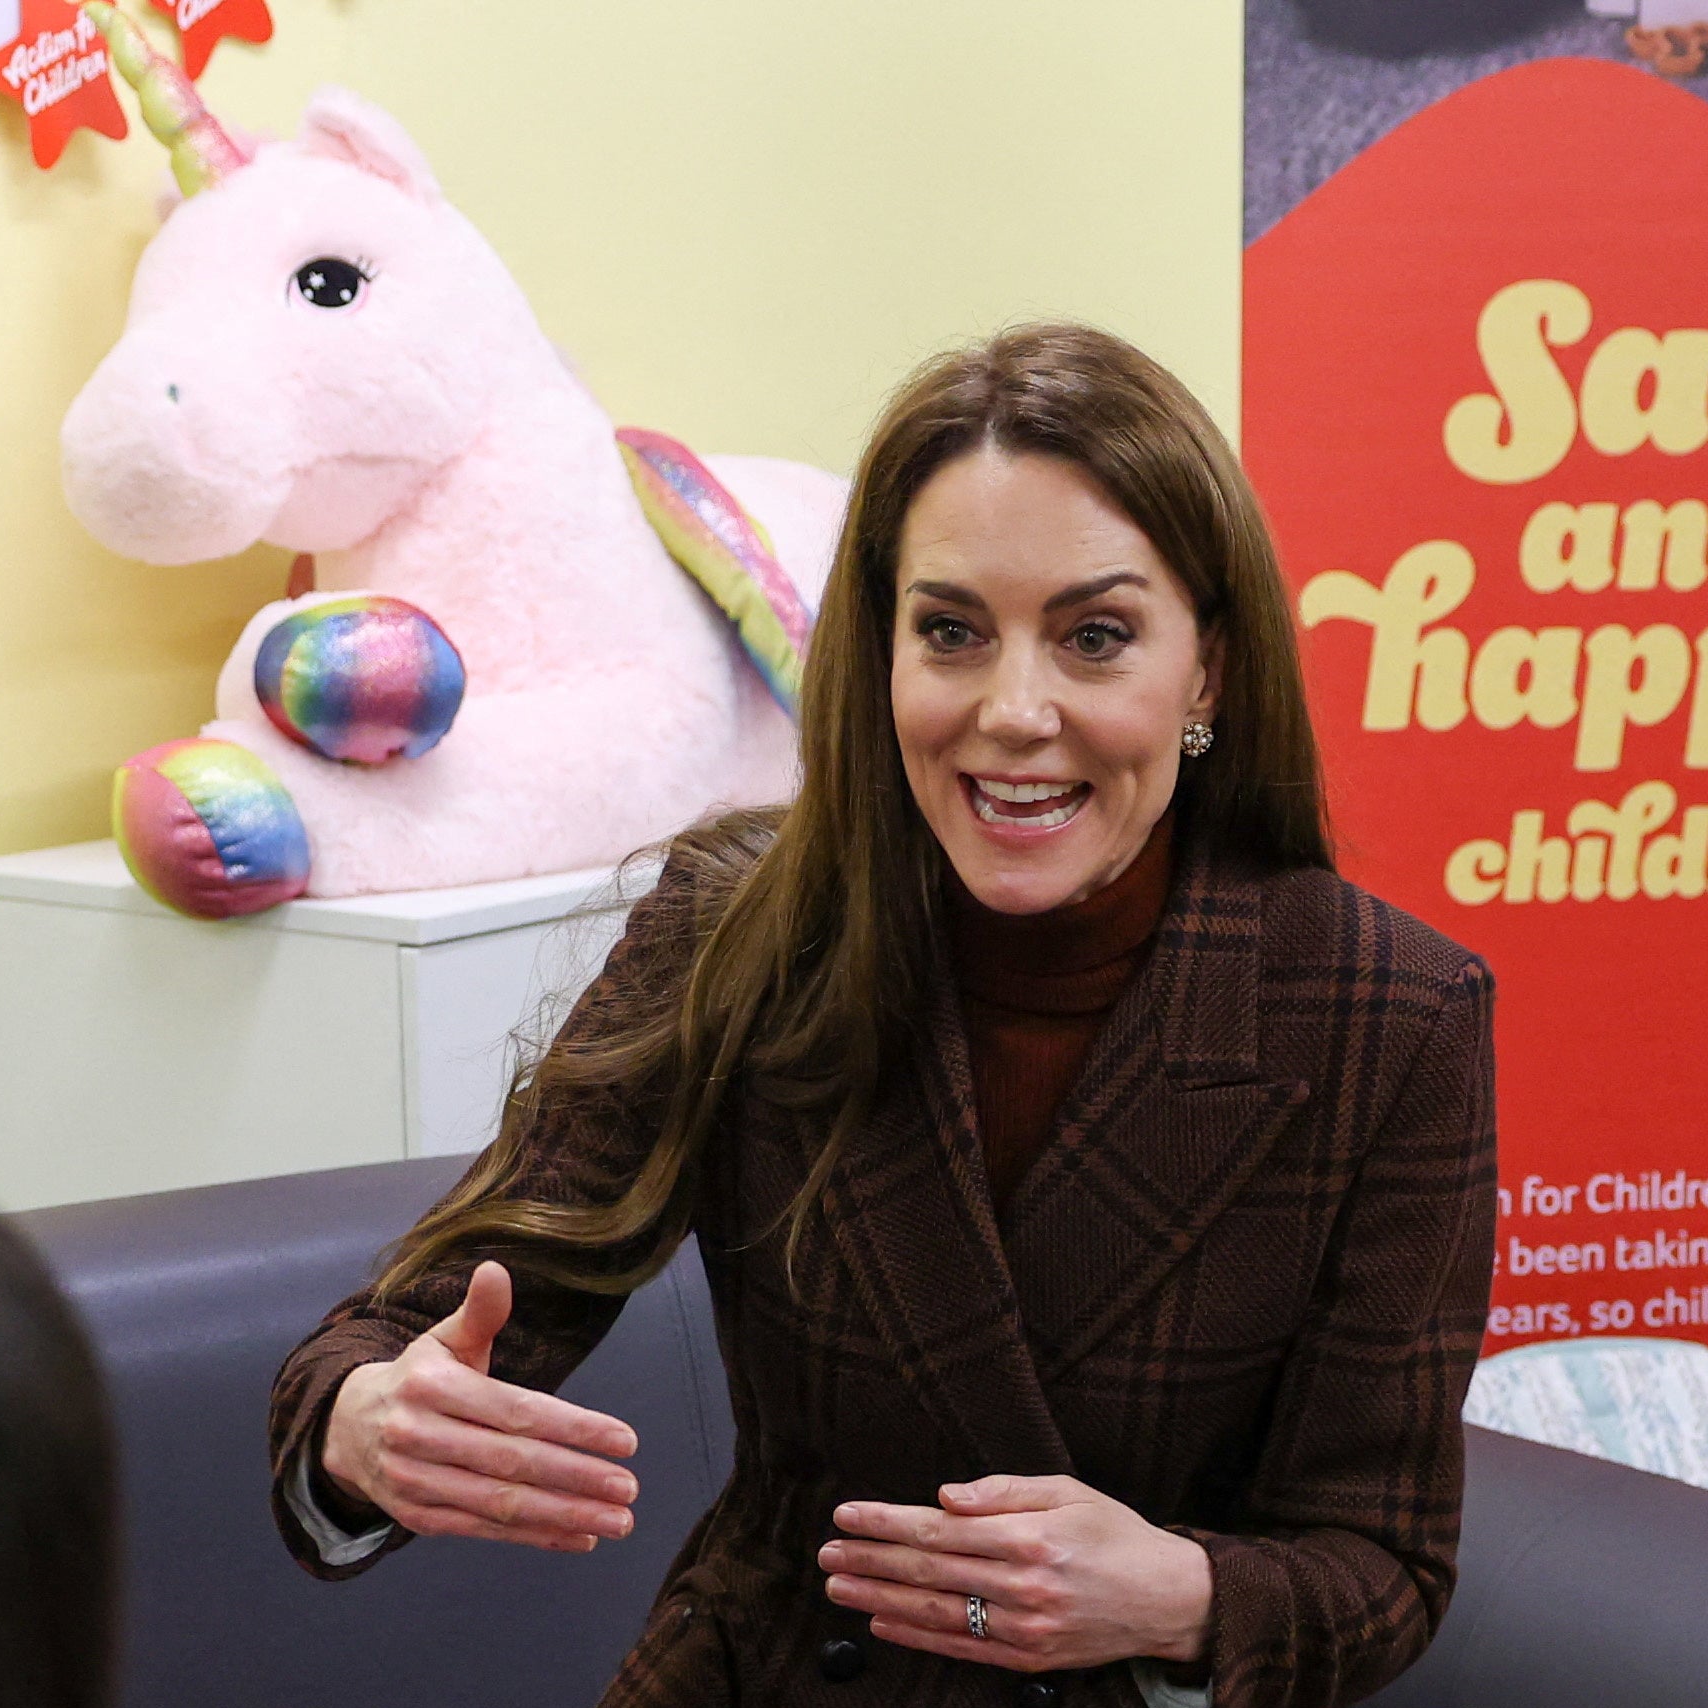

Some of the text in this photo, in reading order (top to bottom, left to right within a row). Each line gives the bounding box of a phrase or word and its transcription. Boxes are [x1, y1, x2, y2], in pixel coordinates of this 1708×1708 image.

[2, 29, 76, 89] Action
[24, 49, 107, 116] Children
[1522, 1175, 1581, 1216] for
[1509, 1236, 1606, 1276] been
[1489, 1303, 1581, 1335] ears,
[1589, 1300, 1634, 1330] so
